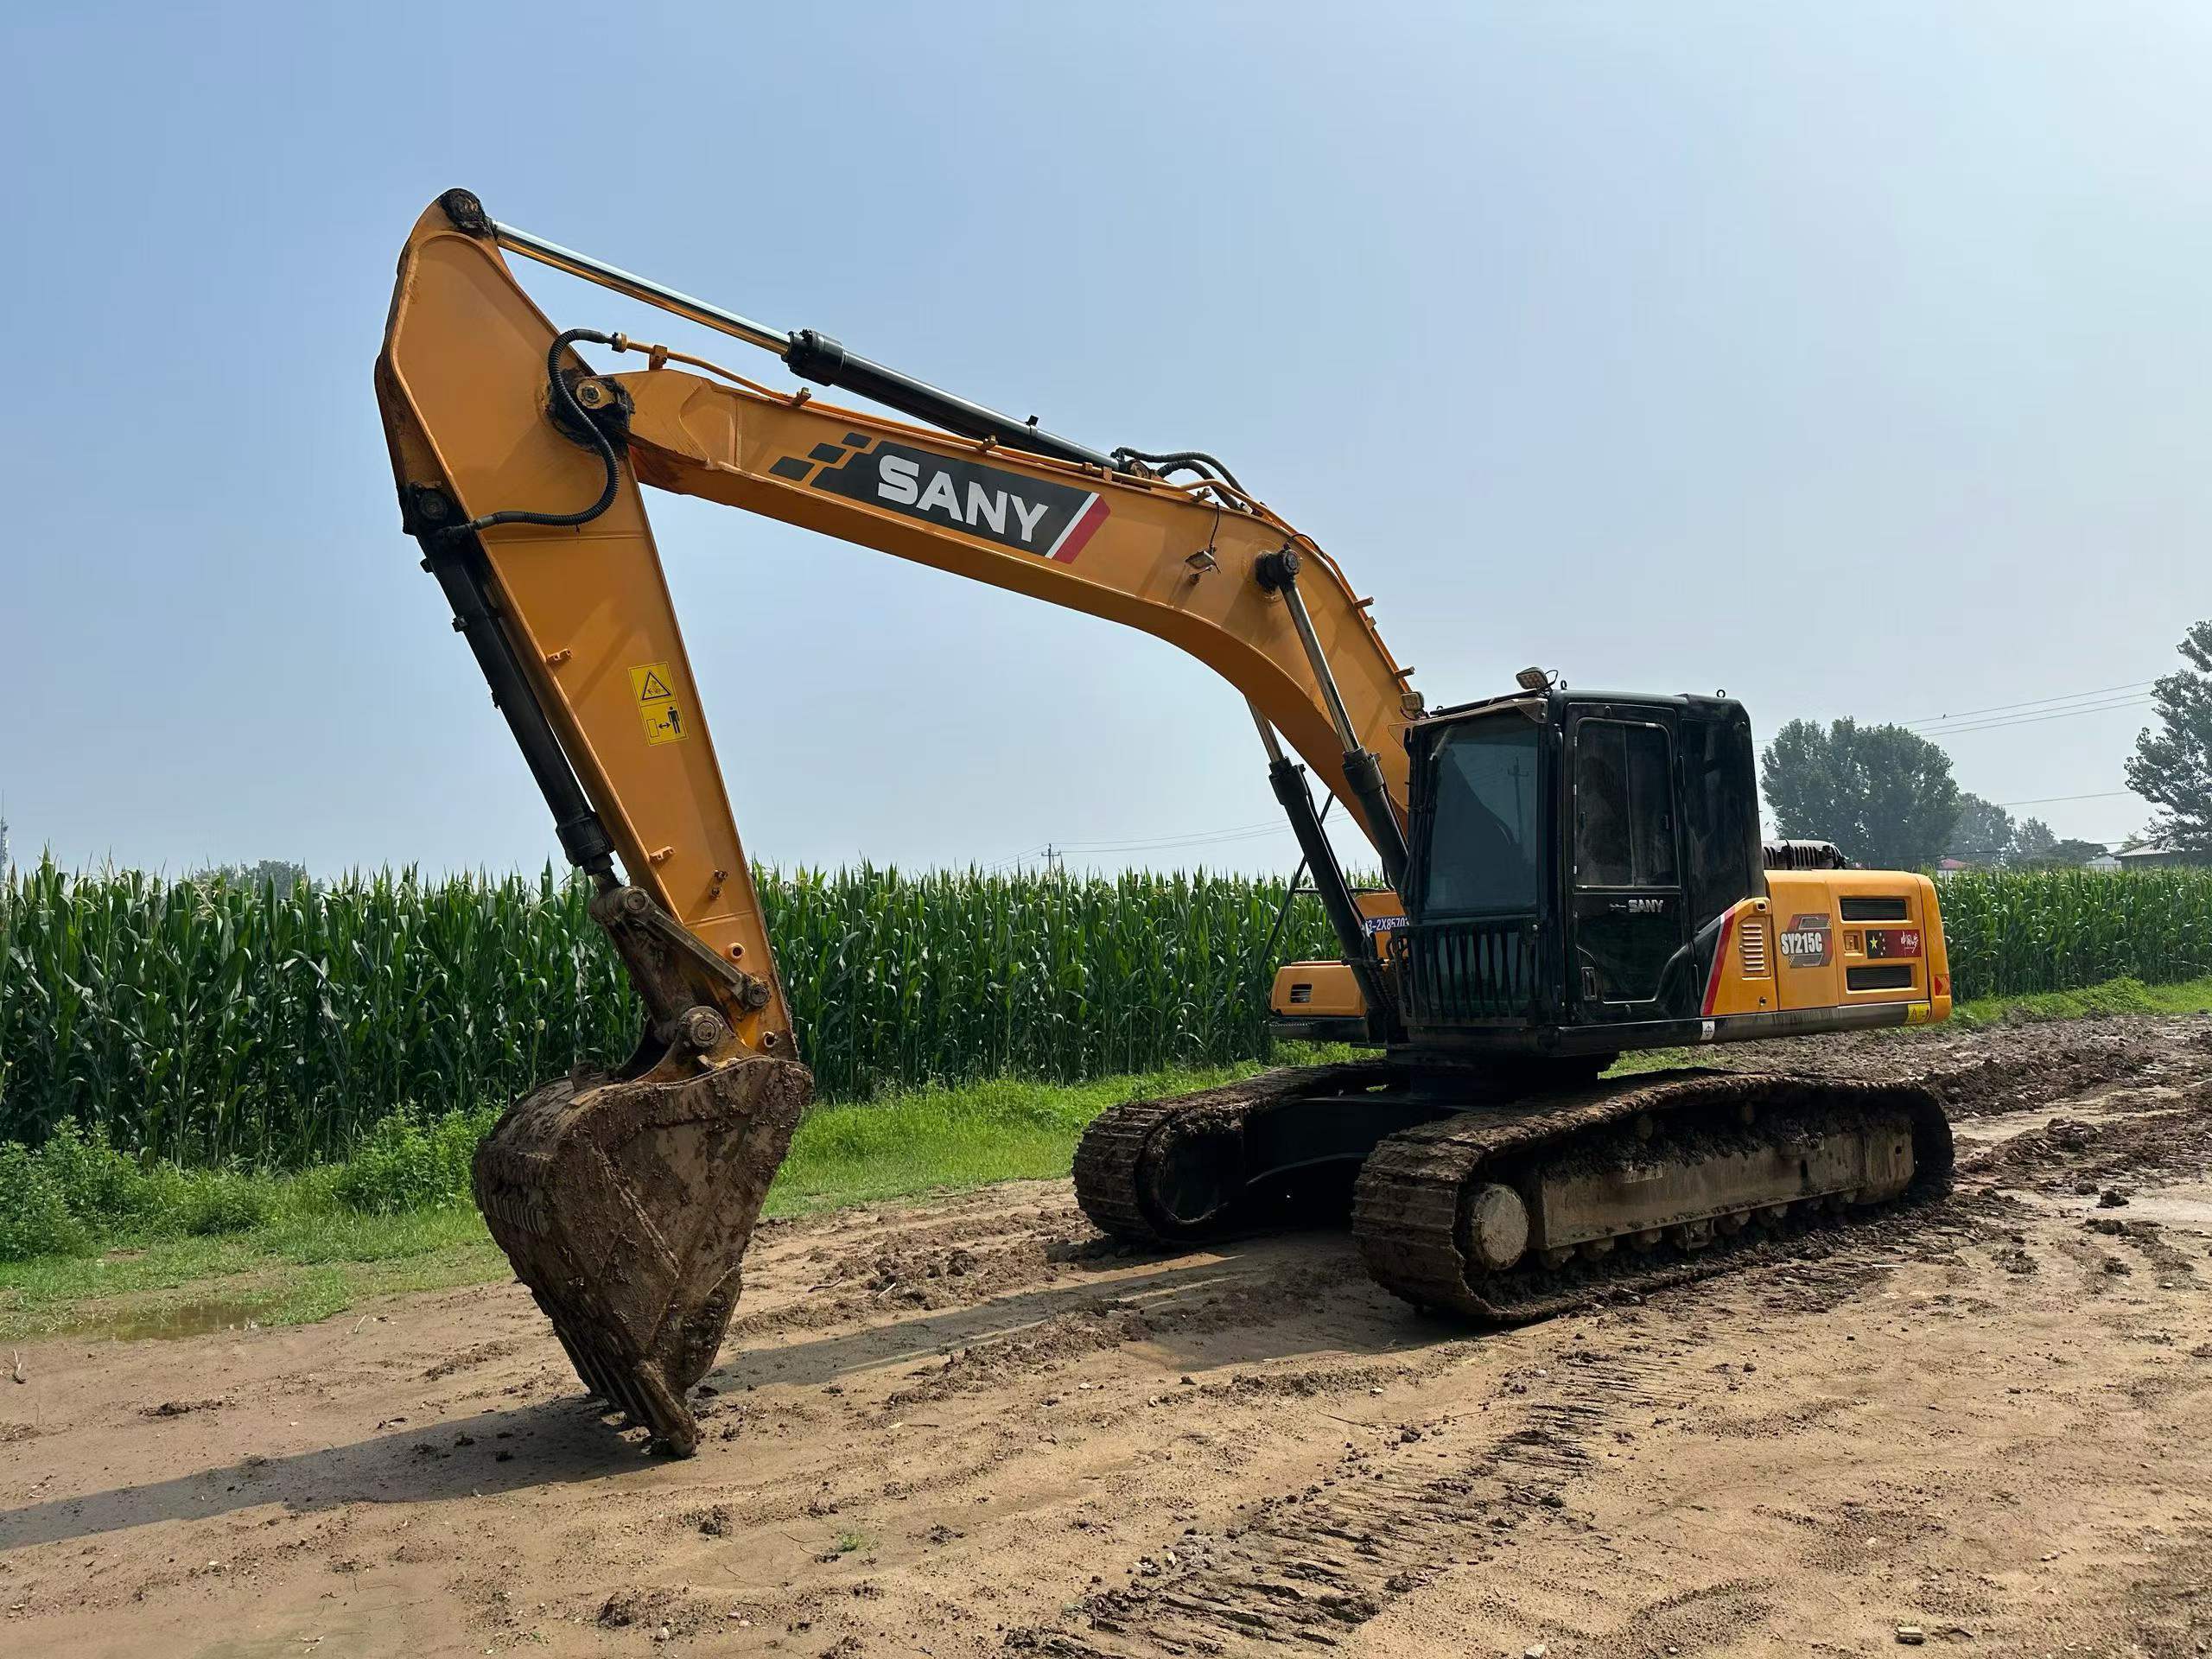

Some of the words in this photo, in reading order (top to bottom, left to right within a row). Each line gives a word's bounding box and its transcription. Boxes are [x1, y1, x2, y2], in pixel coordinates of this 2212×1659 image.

[878, 454, 1048, 543] SANY
[1628, 899, 1664, 913] SANY
[1780, 932, 1822, 955] SY215C
